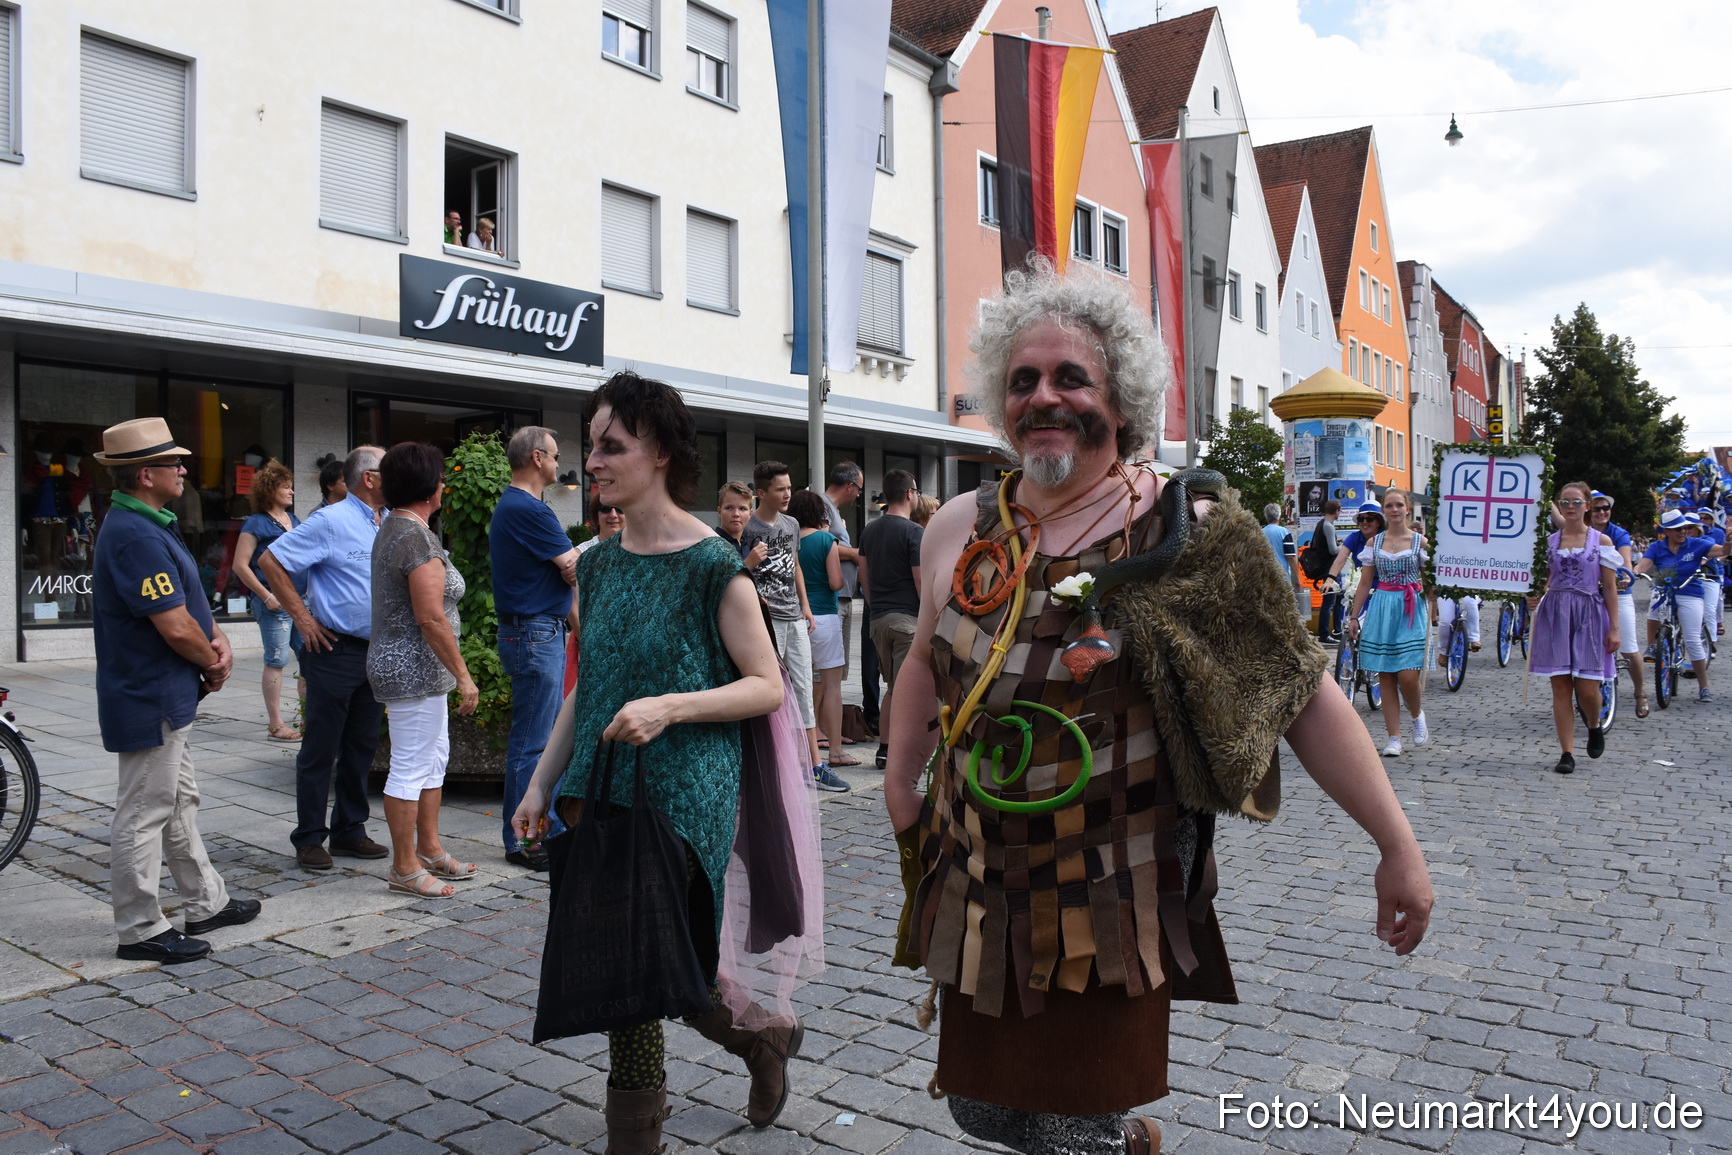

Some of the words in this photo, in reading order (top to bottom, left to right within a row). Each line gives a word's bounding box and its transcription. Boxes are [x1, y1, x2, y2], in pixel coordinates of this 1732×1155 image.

[413, 274, 599, 352] frühauf
[1463, 470, 1481, 491] K
[1498, 471, 1518, 492] D
[1460, 506, 1478, 527] F
[1496, 508, 1515, 530] B
[1437, 566, 1529, 582] FRAUENBUND
[1438, 554, 1488, 567] Katholischer
[1489, 557, 1529, 570] Deutscher
[140, 572, 175, 601] 48
[567, 982, 683, 1025] AUGSBURG
